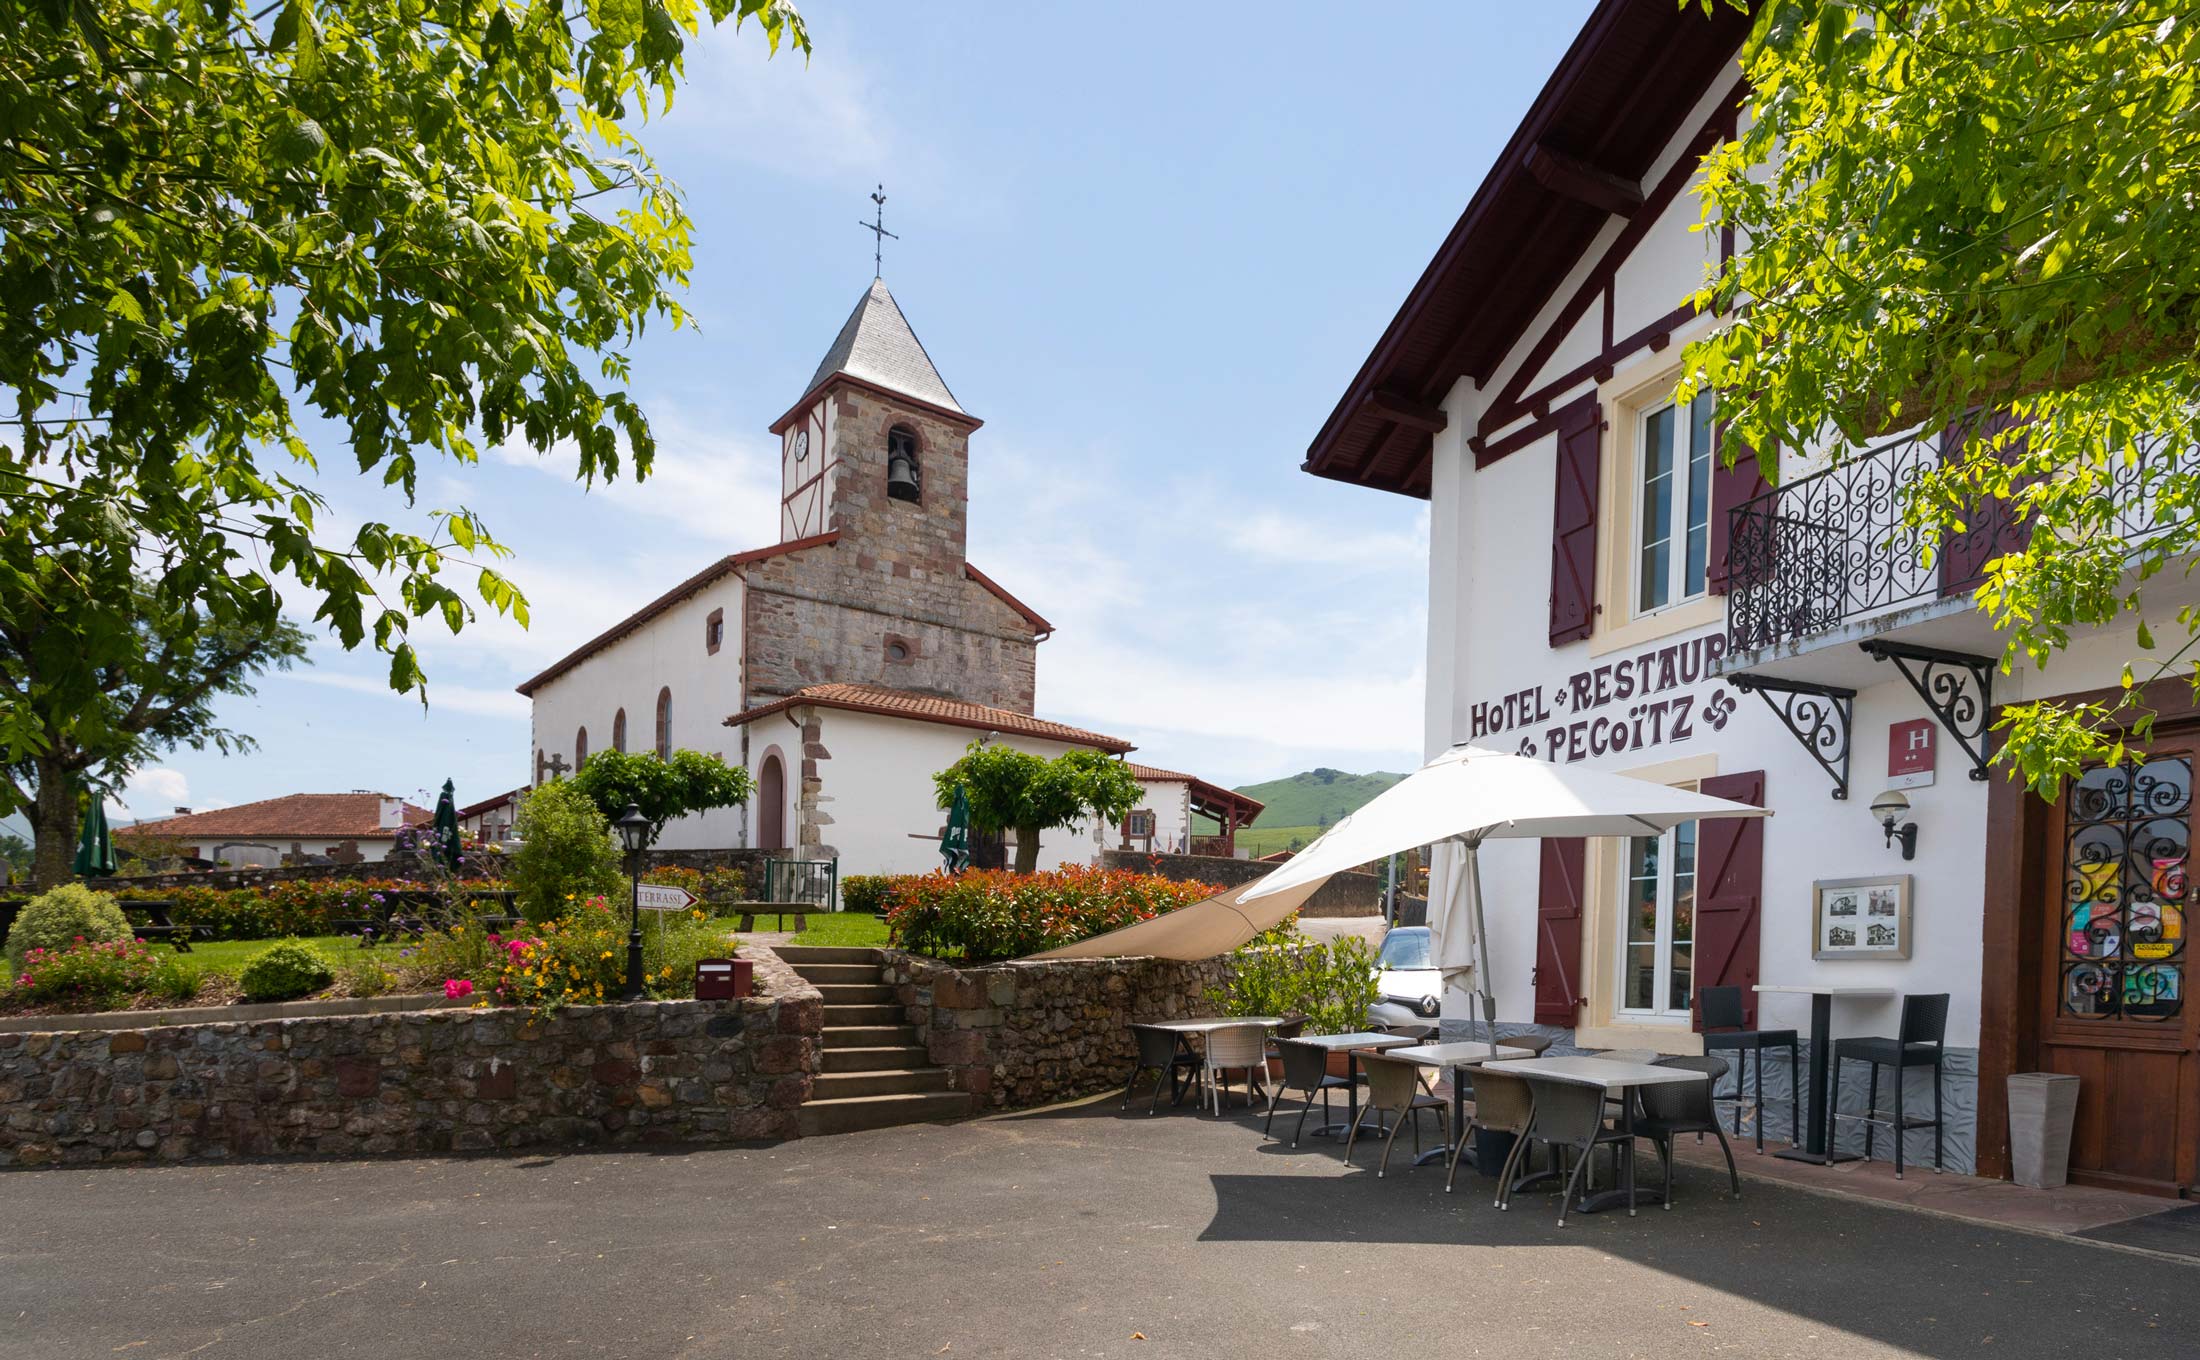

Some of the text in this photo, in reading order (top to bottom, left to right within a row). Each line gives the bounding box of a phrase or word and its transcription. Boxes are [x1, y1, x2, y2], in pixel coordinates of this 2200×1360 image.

[1470, 685, 1551, 739] HOTEL
[1909, 728, 1929, 750] H
[638, 891, 682, 904] TERRASSE
